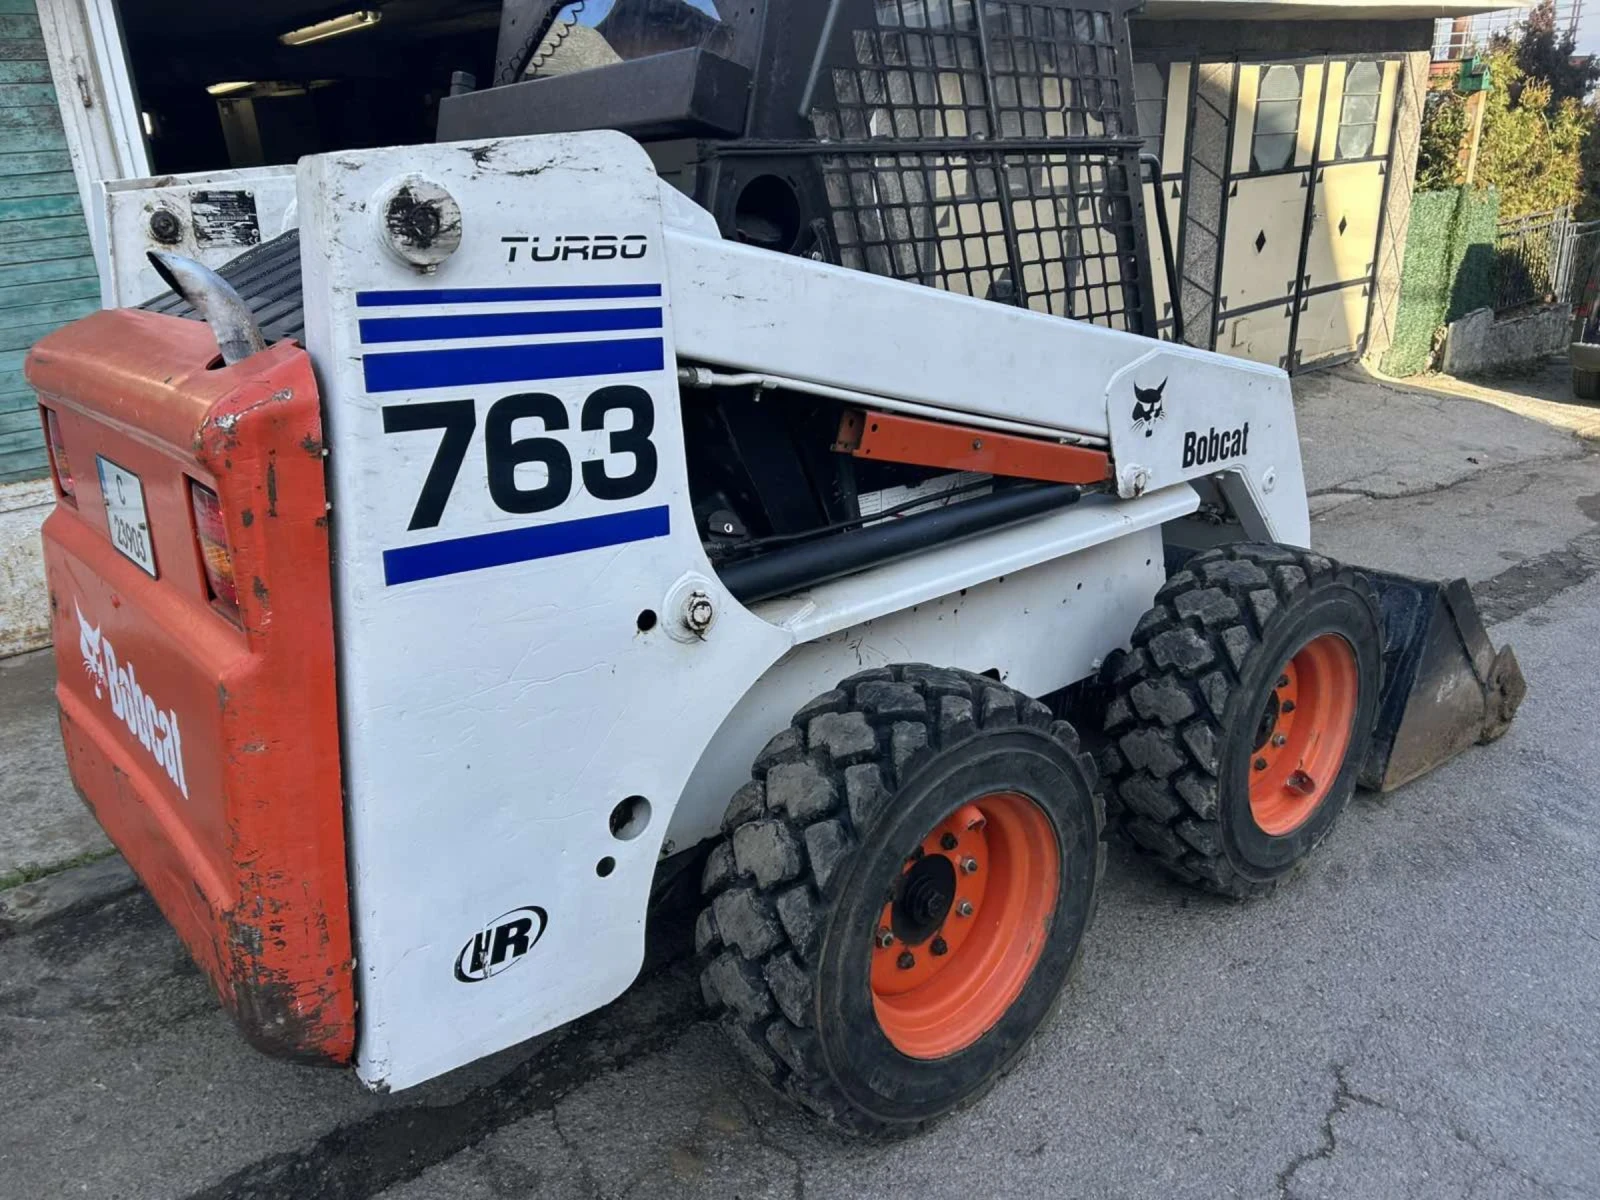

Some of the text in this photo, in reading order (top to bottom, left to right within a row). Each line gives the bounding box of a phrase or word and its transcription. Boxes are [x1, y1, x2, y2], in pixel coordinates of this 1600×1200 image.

[501, 235, 647, 262] TURBO
[382, 385, 658, 531] 763
[1182, 421, 1249, 469] Bobcat
[115, 474, 126, 506] C
[114, 514, 147, 562] 23903
[102, 636, 188, 800] Bobcat
